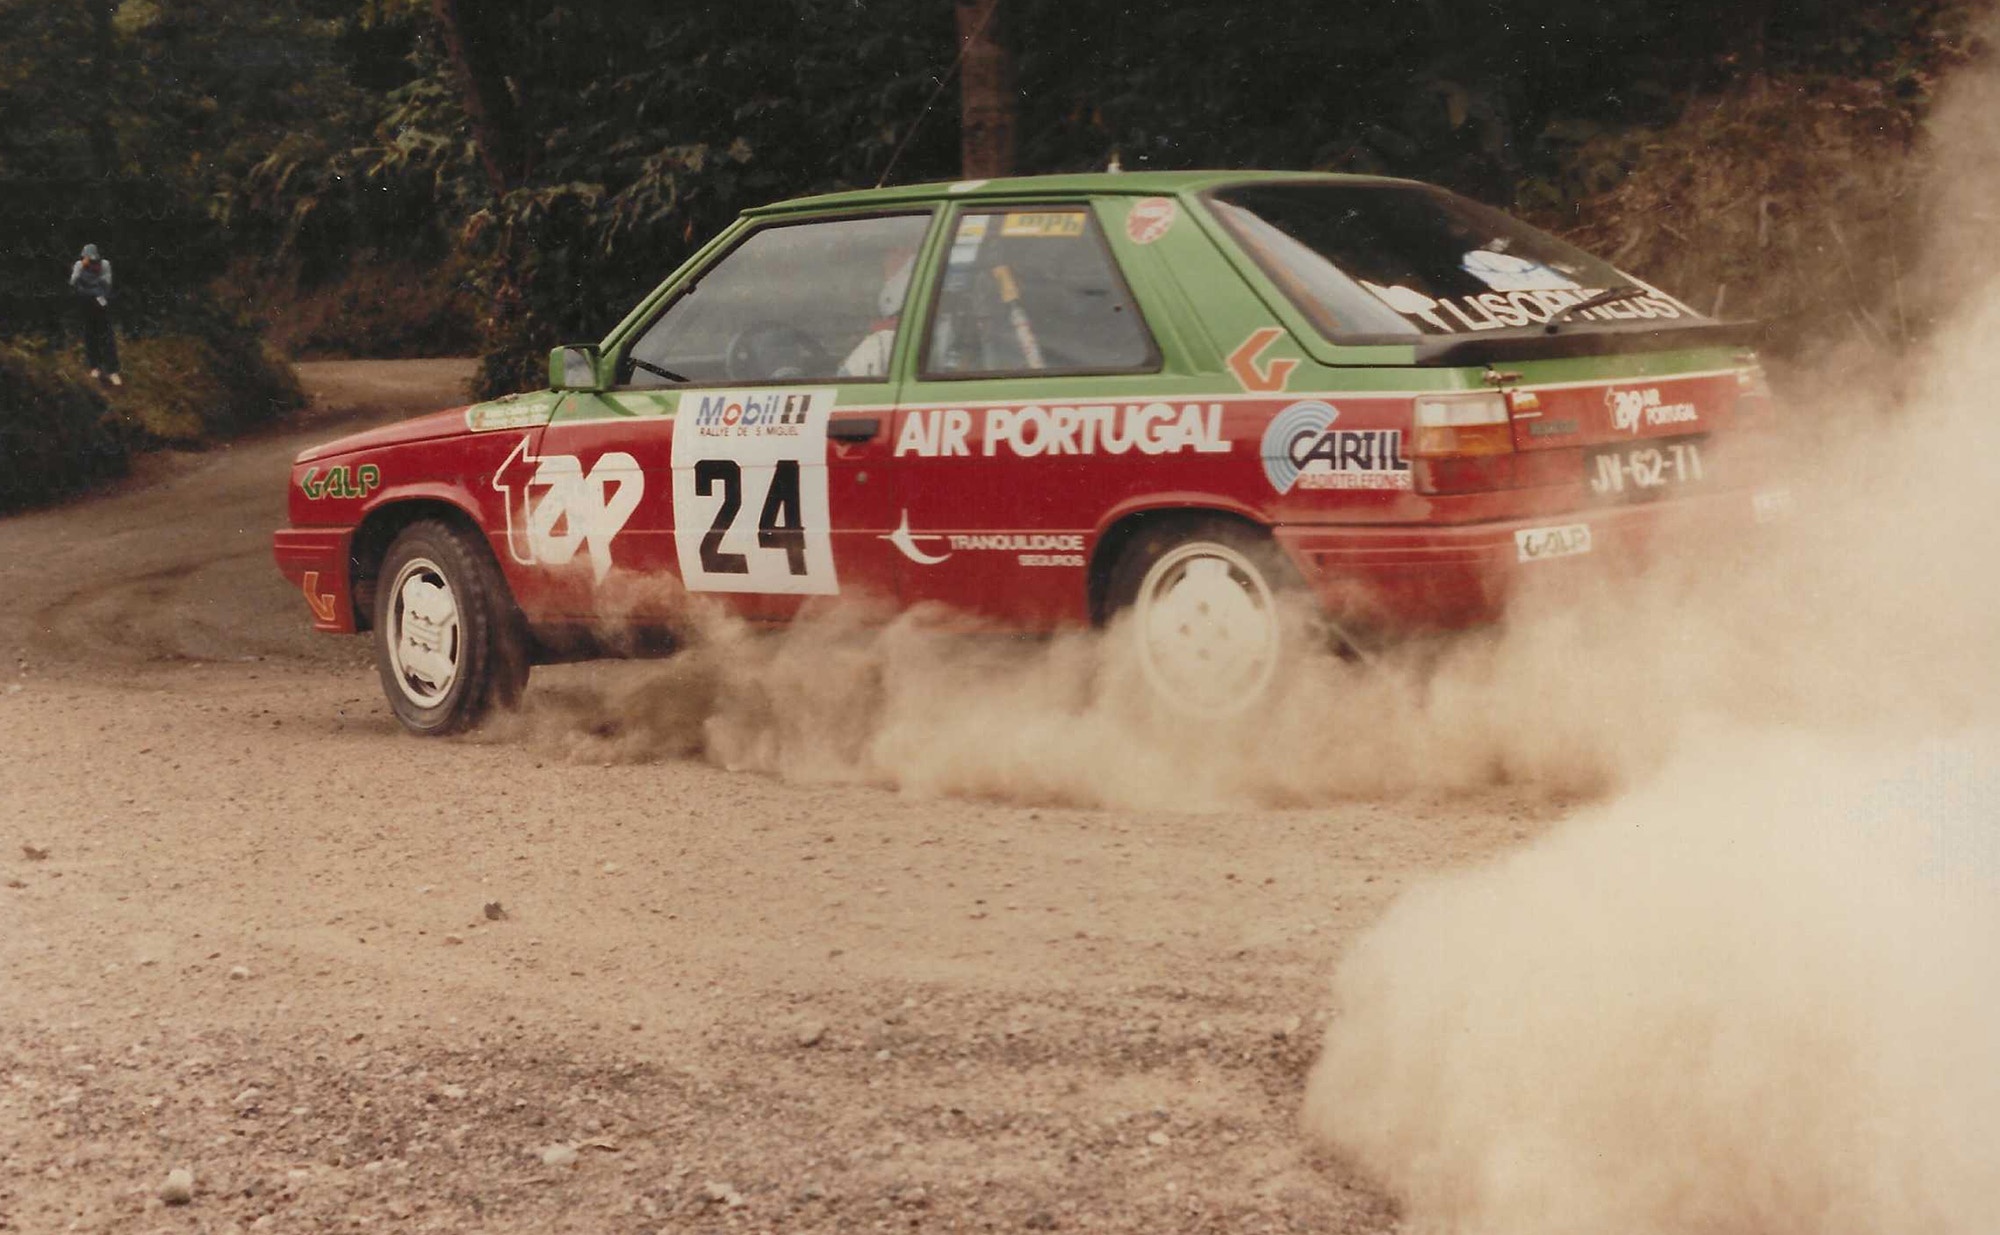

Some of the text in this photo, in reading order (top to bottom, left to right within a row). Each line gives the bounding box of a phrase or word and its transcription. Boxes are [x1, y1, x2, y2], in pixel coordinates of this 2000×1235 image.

[696, 395, 779, 426] Mobil
[699, 427, 729, 437] RALLYE
[737, 427, 748, 437] DE
[894, 403, 1232, 457] AIR PORTUGAL
[1289, 430, 1409, 470] CARTIL
[300, 464, 380, 500] GALP
[694, 459, 808, 576] 24
[948, 534, 1085, 551] TRANQUILIDADE
[1018, 555, 1085, 566] SEGUROS
